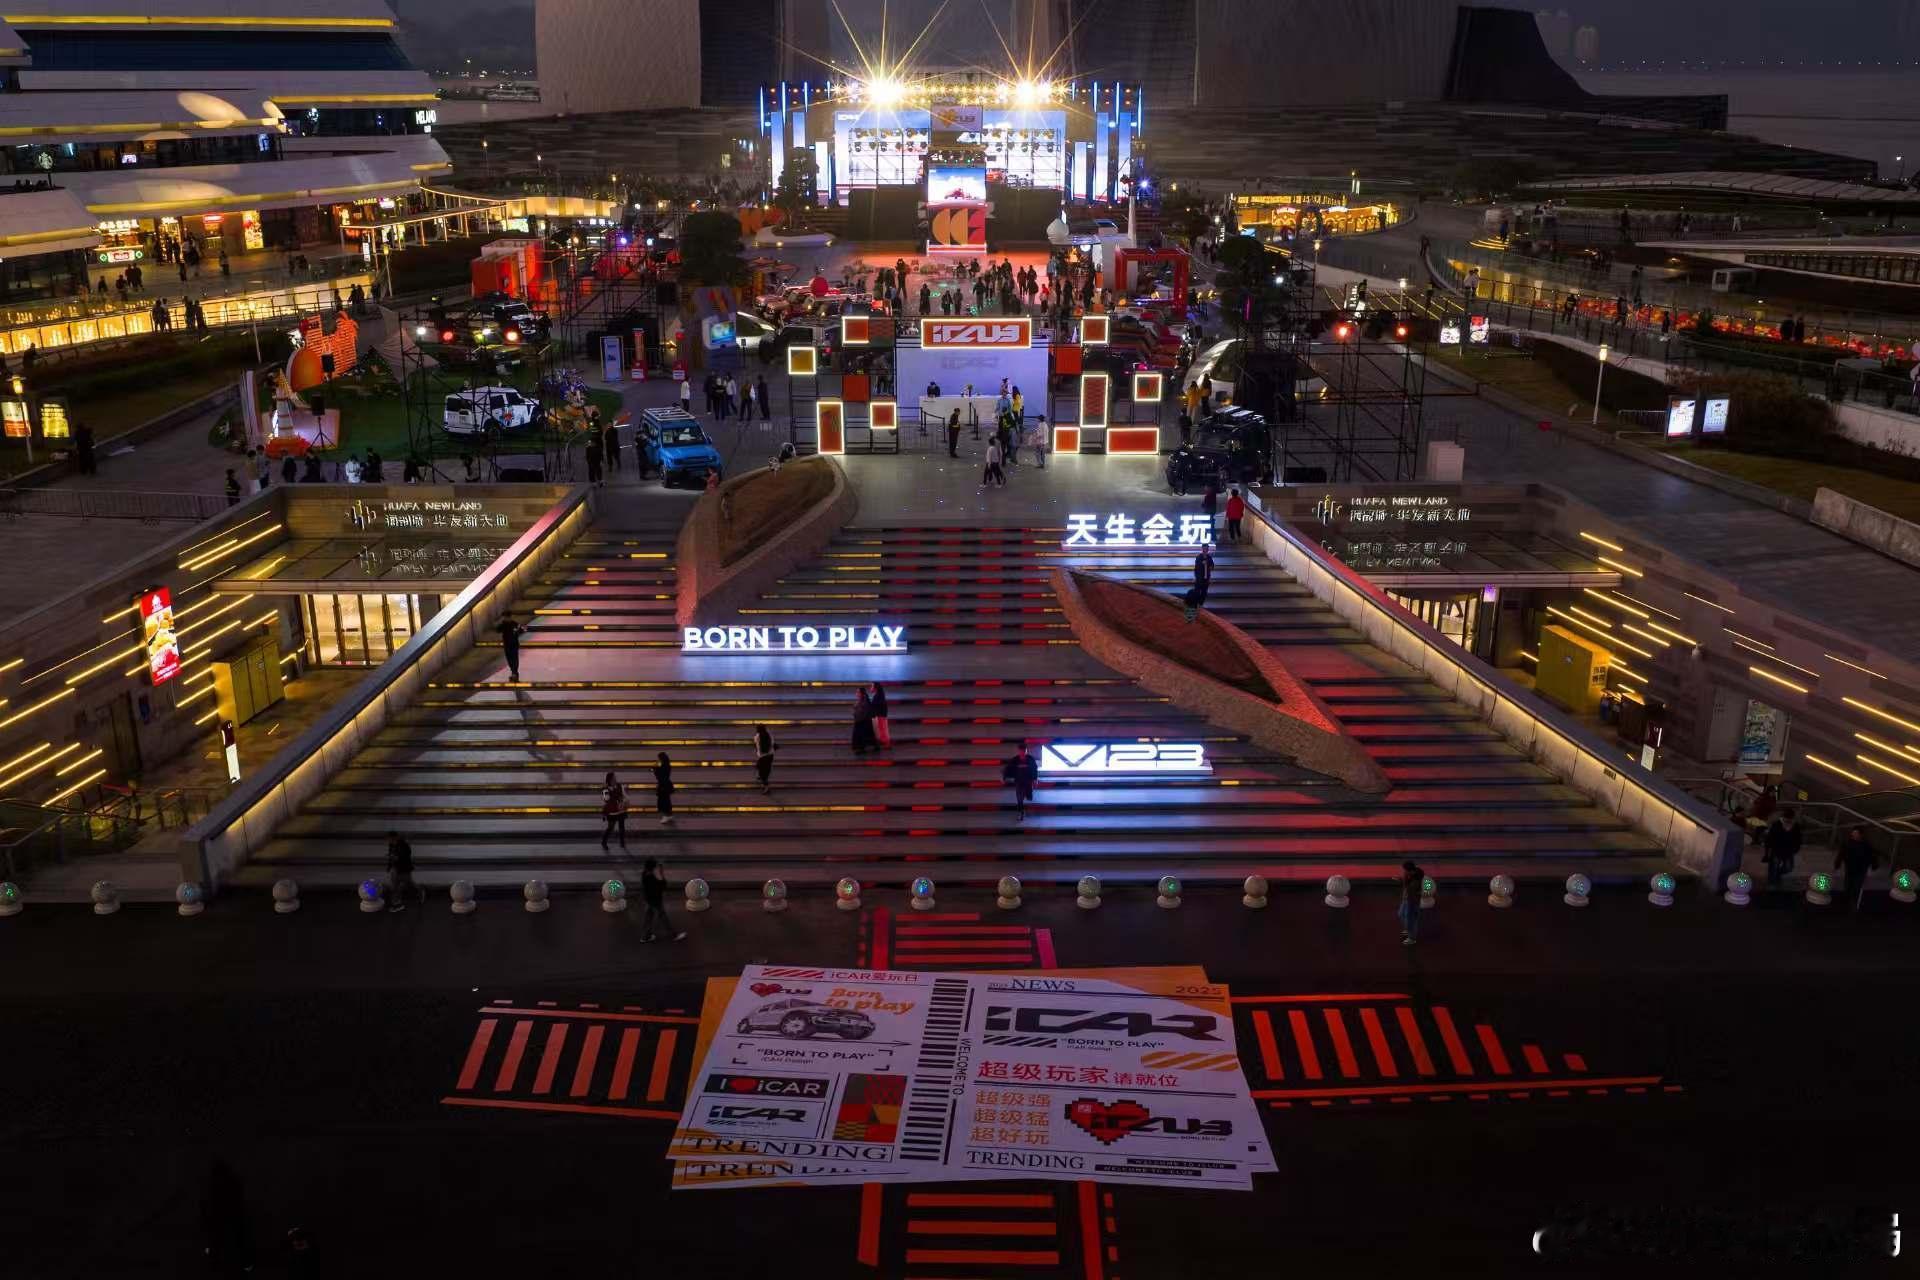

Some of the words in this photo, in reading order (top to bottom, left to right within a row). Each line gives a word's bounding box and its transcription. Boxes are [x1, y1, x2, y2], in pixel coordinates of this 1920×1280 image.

[1066, 512, 1212, 546] 天生会玩
[683, 626, 769, 650] BORN
[777, 626, 820, 650] TO
[829, 626, 905, 650] PLAY
[830, 987, 883, 998] Born
[1011, 978, 1075, 991] NEWS
[1175, 986, 1222, 996] 2025
[825, 997, 848, 1008] to
[854, 997, 916, 1016] play
[984, 1005, 1225, 1042] iCAR
[1109, 1039, 1124, 1047] TO
[811, 1050, 829, 1059] TO
[953, 1038, 971, 1081] WELCOME
[977, 1060, 1109, 1085] 超级玩家
[1113, 1071, 1179, 1088] 请就位
[757, 1078, 820, 1096] iCAR
[951, 1082, 965, 1096] TO
[975, 1089, 1051, 1107] 超级强
[973, 1107, 1050, 1126] 超级猛
[969, 1126, 1050, 1145] 超好玩
[687, 1136, 888, 1161] TRENDING
[967, 1150, 1085, 1170] TRENDING
